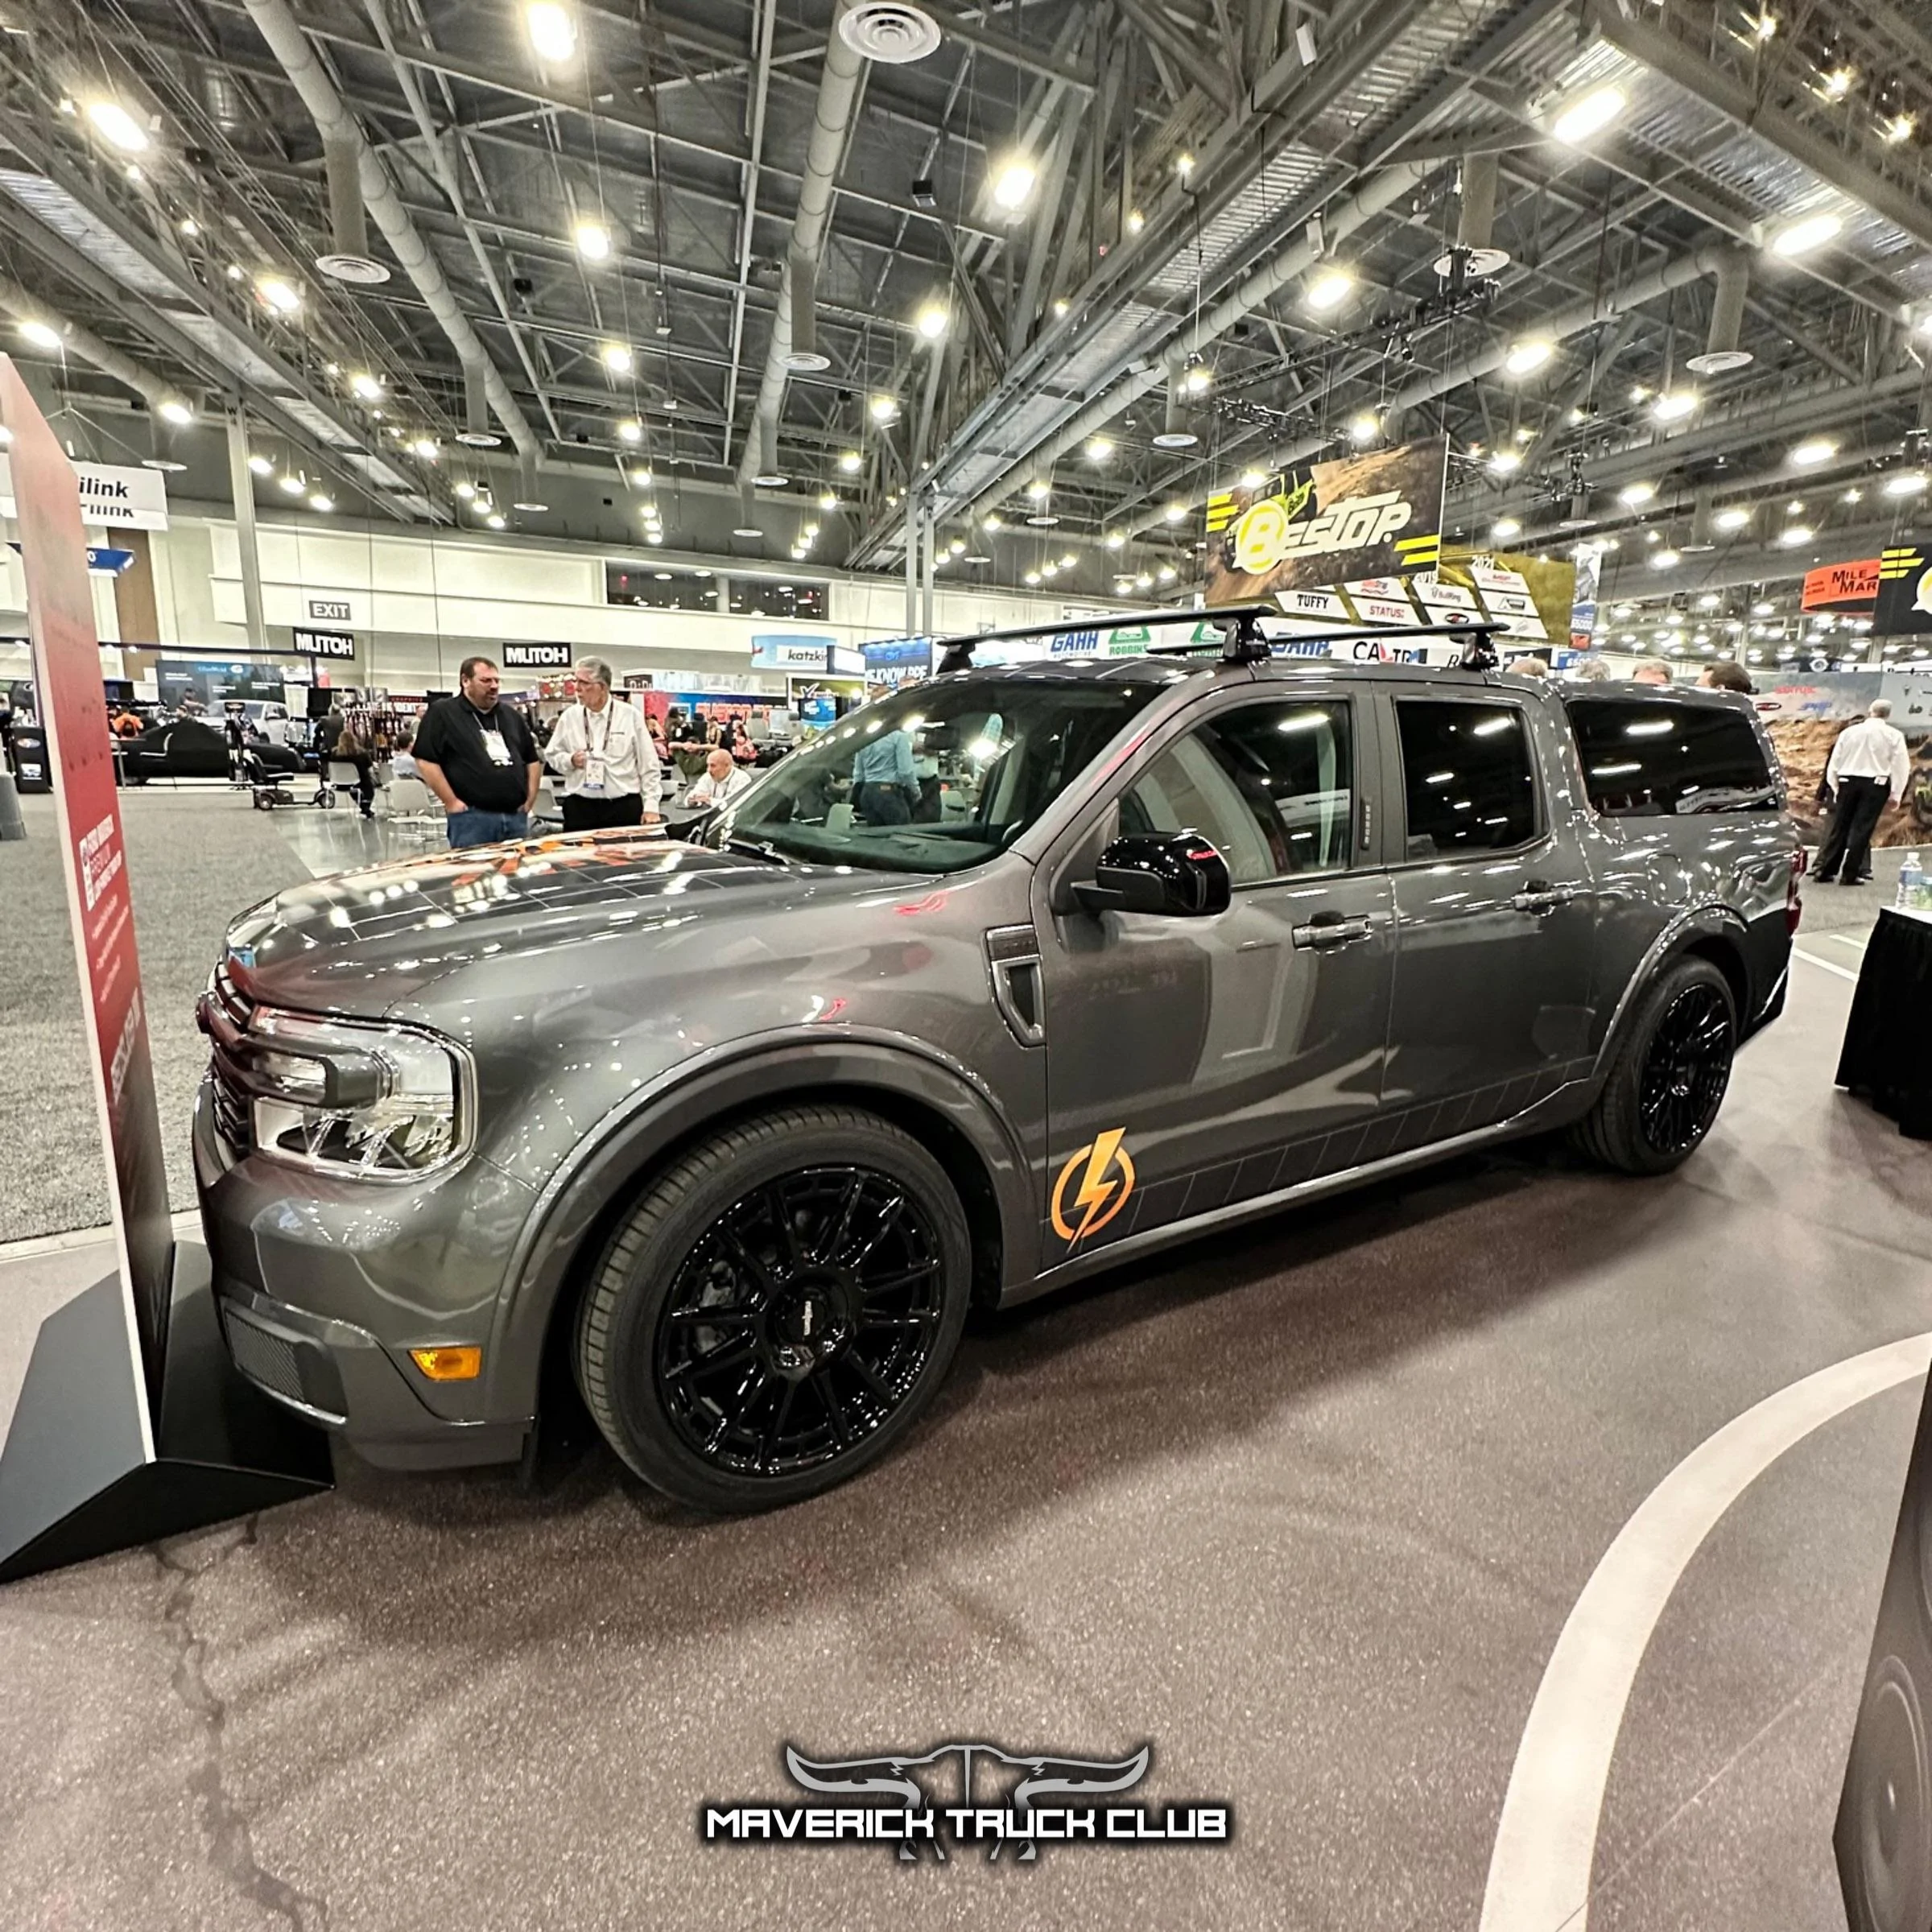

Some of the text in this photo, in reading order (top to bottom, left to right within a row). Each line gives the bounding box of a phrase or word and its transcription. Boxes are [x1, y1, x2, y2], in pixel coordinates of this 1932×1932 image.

[1831, 568, 1868, 584] MILE
[1297, 594, 1329, 609] TUFFY
[312, 604, 349, 619] EXIT
[295, 633, 353, 656] MUTOH
[1051, 629, 1100, 652] GAHH
[506, 647, 569, 664] MUTOH
